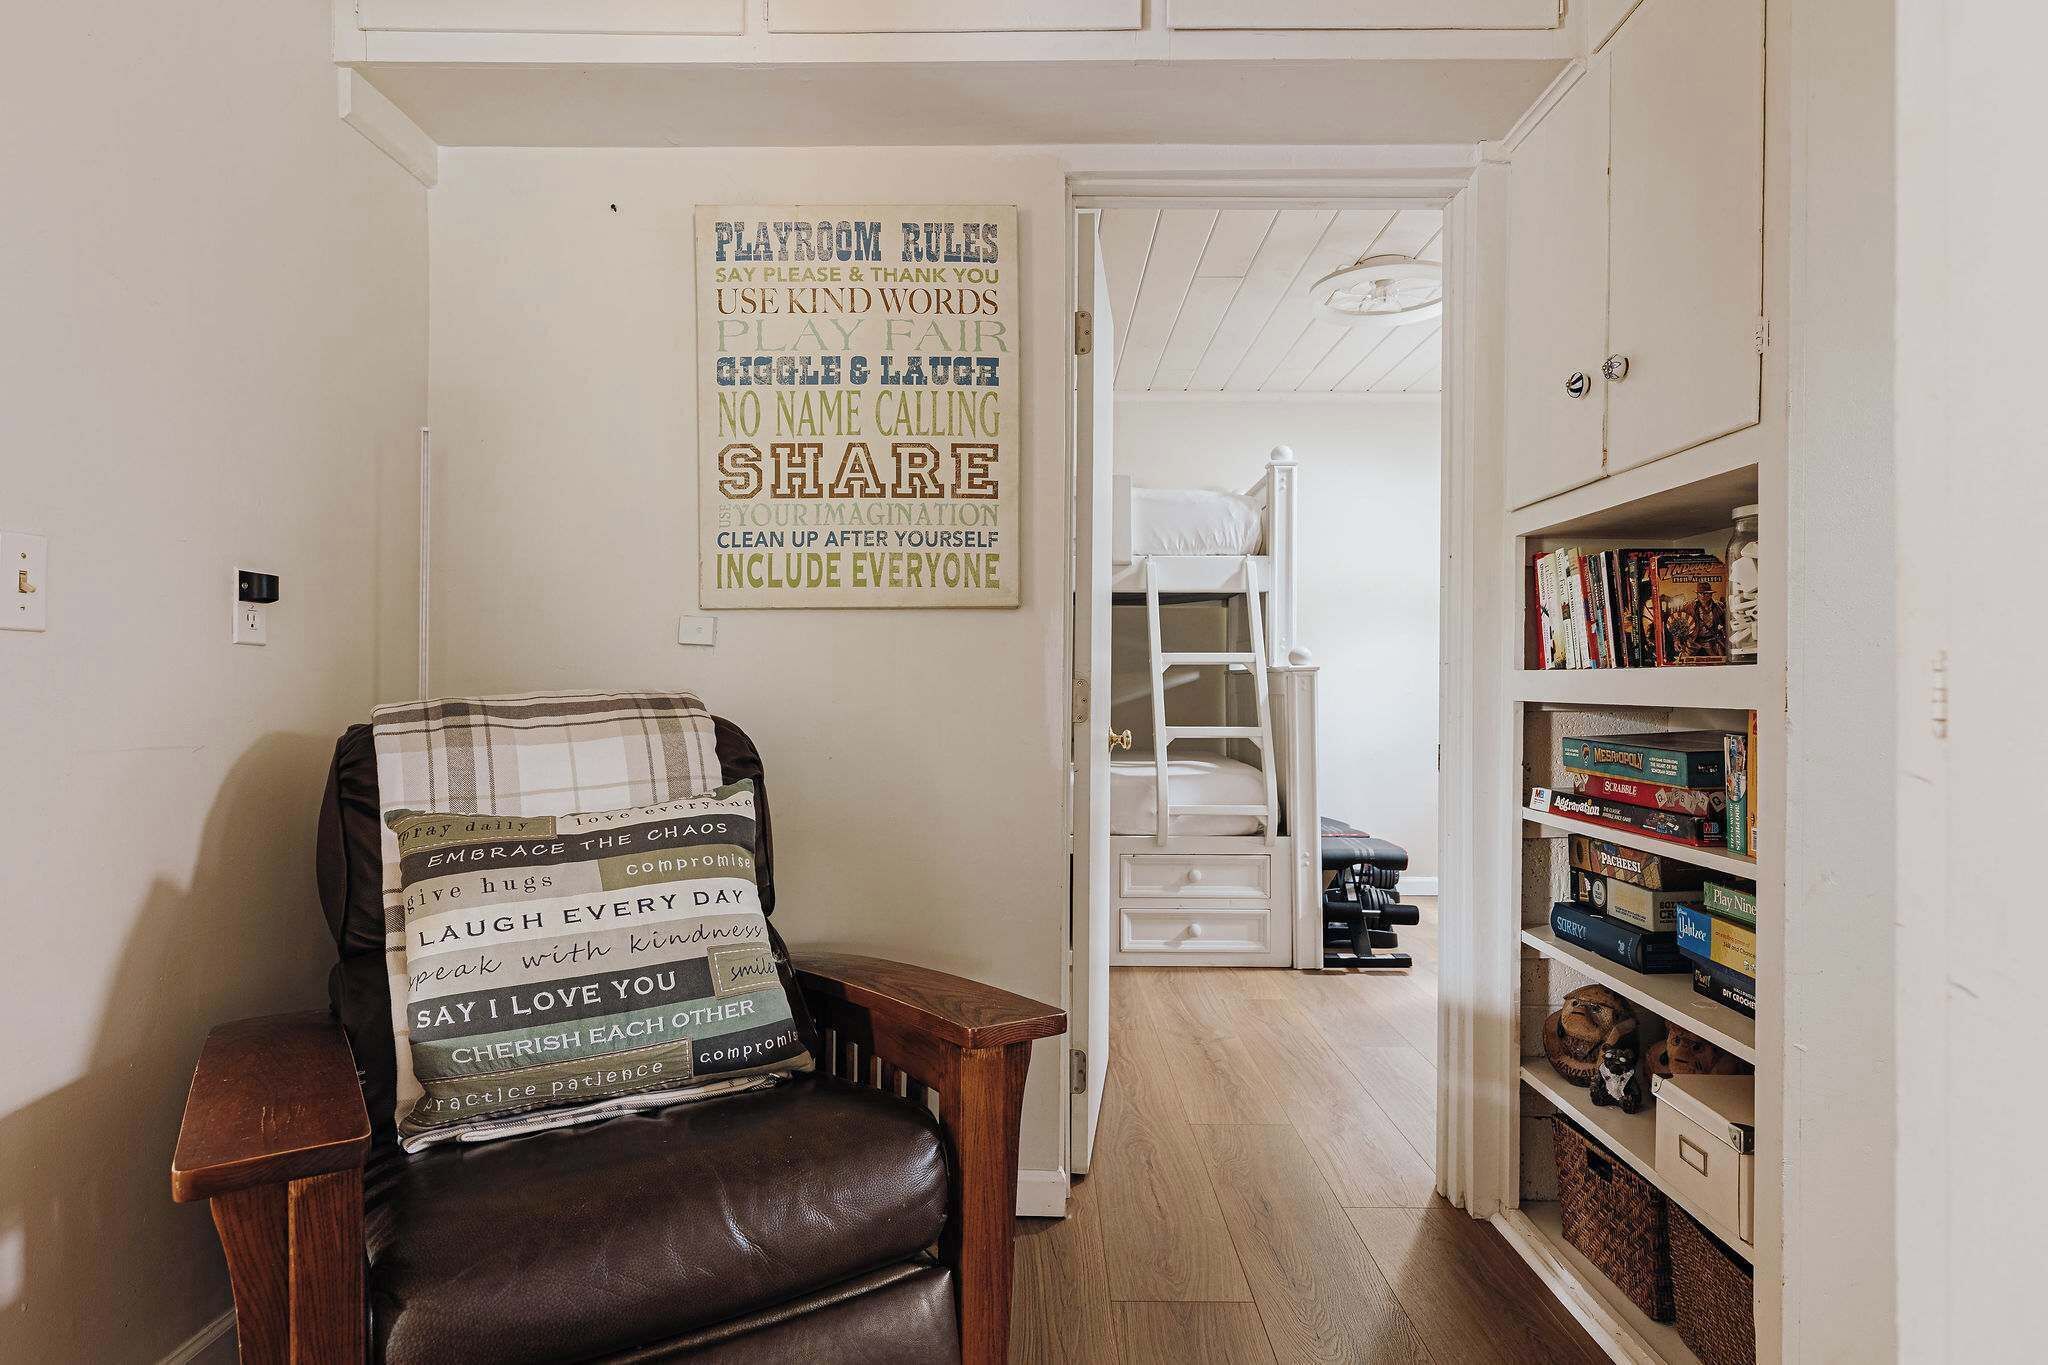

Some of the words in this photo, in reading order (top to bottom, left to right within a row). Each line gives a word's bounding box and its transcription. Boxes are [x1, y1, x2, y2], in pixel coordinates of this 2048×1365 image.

[714, 221, 882, 262] PLAYROOM
[901, 222, 999, 265] RULES
[715, 267, 756, 283] SAY
[764, 267, 843, 283] PLEASE
[849, 267, 864, 283] &
[870, 267, 947, 284] THANK
[953, 268, 999, 284] YOU
[716, 288, 779, 315] USE
[788, 287, 872, 315] KIND
[877, 288, 999, 316] WORDS
[716, 318, 866, 352] PLAY
[884, 318, 1010, 353] FAIR
[716, 356, 841, 386] GIGGLE
[849, 356, 870, 386] &
[880, 356, 1000, 387] LAUGH
[718, 391, 762, 438] NO
[775, 391, 863, 438] NAME
[875, 391, 1000, 438] CALLING
[717, 442, 1000, 500] SHARE
[736, 502, 809, 527] YOUR
[815, 502, 1000, 528] IMAGINATION
[717, 530, 785, 549] CLEAN
[792, 530, 818, 548] UP
[825, 530, 888, 548] AFTER
[894, 530, 1000, 549] YOURSELF
[716, 552, 841, 589] INCLUDE
[852, 552, 1000, 589] EVERYONE
[1604, 781, 1638, 796] SCRABBLE
[576, 813, 630, 828] love
[645, 799, 753, 816] everyone
[1554, 796, 1600, 816] Aggravation
[465, 819, 529, 832] daily
[427, 842, 566, 868] EMBRACE
[580, 834, 632, 851] THE
[647, 823, 728, 841] CHAOS
[626, 853, 752, 876] compromise
[1600, 852, 1641, 874] PACHEESI
[406, 886, 463, 915] give
[480, 876, 553, 894] hugs
[1713, 888, 1732, 911] Play
[1734, 896, 1756, 916] Nine
[418, 912, 544, 947] LAUGH
[563, 893, 678, 924] EVERY
[692, 889, 744, 907] DAY
[1679, 915, 1706, 942] Yahtzee
[522, 940, 611, 969] with
[629, 923, 764, 954] kindness
[416, 1001, 477, 1029] SAY
[489, 998, 499, 1019] I
[511, 982, 602, 1016] LOVE
[611, 970, 677, 1000] YOU
[1722, 988, 1732, 1000] DIY
[451, 1031, 582, 1064] CHERISH
[589, 1016, 665, 1046] EACH
[671, 999, 756, 1028] OTHER
[551, 1061, 664, 1098] patience
